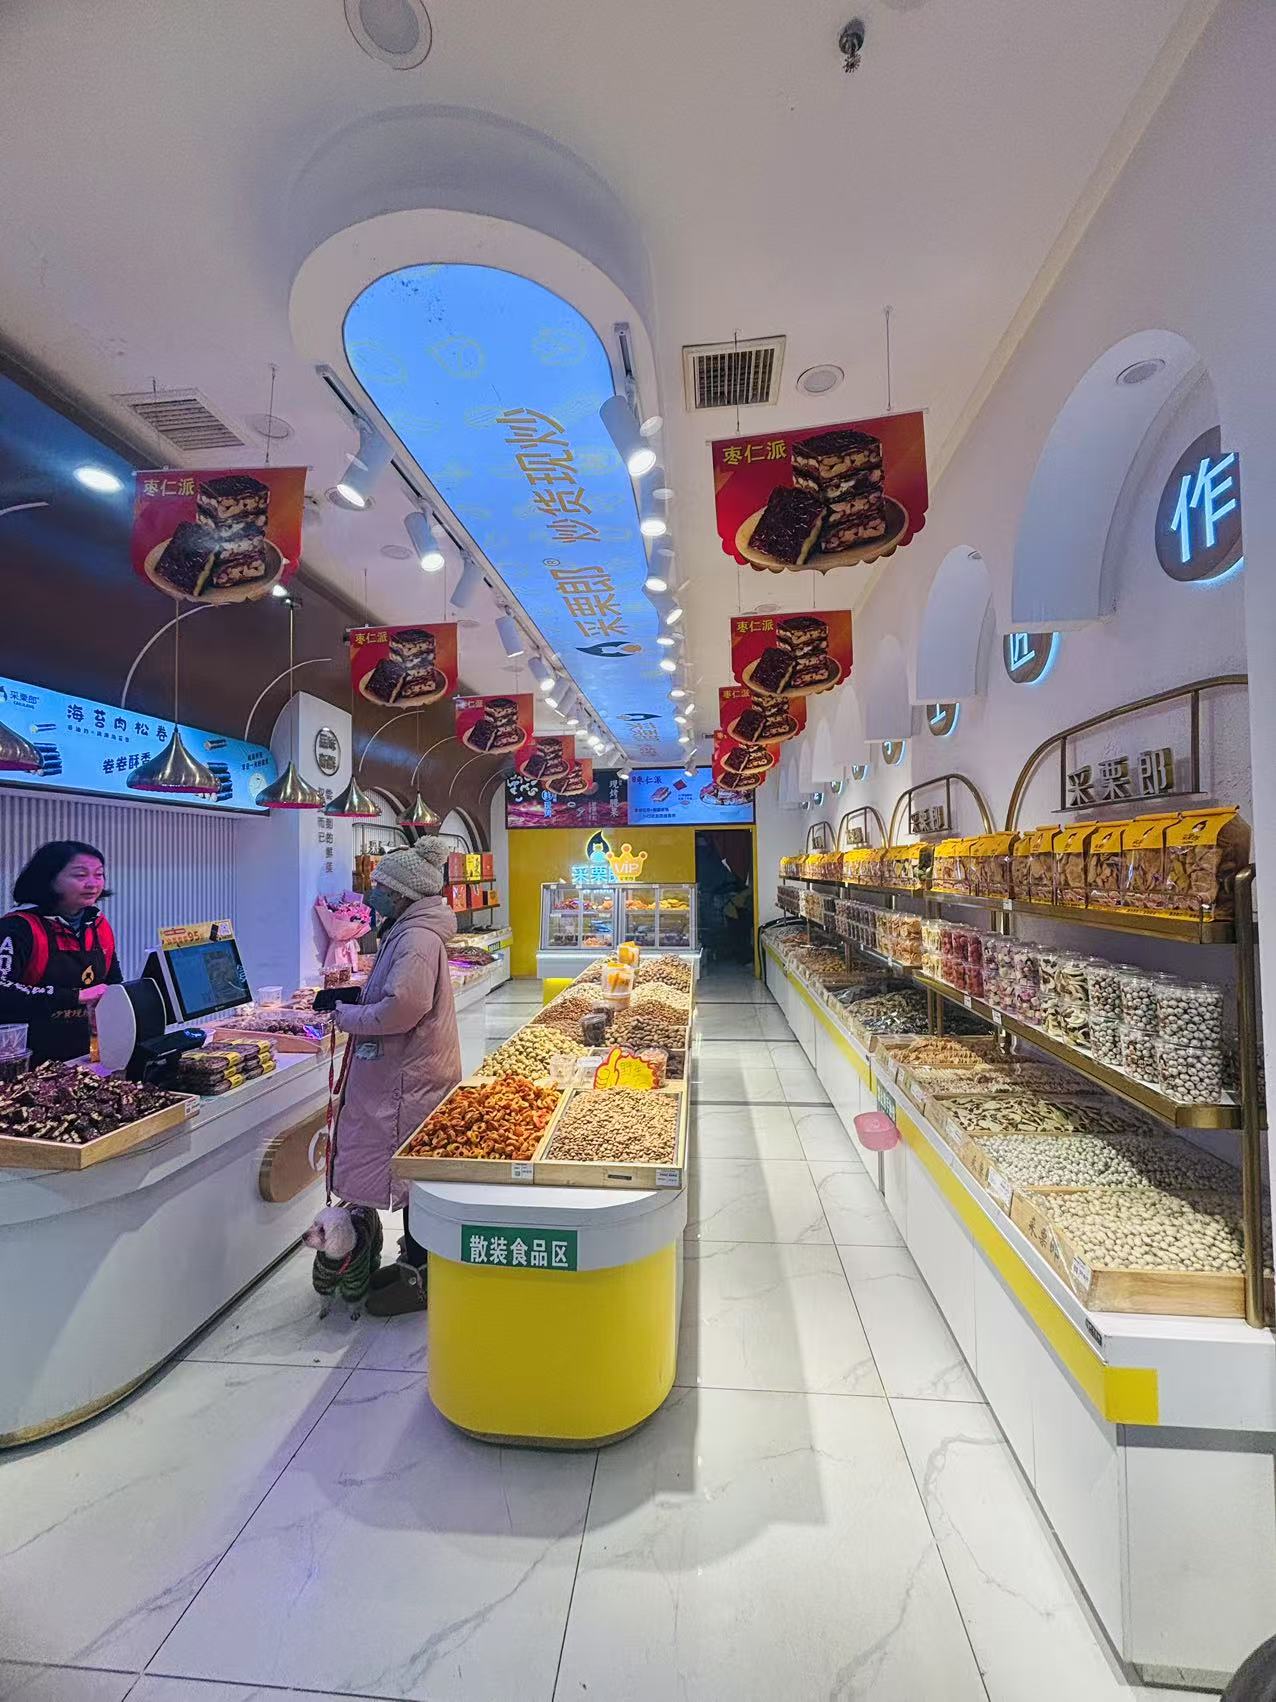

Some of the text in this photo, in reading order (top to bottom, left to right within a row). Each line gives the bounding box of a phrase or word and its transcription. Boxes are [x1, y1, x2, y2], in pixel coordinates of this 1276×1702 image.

[722, 440, 787, 465] 枣仁派
[143, 478, 195, 497] 枣仁派
[495, 406, 602, 543] 炒货现炒
[1170, 452, 1237, 563] 作
[354, 631, 388, 645] 枣仁派
[736, 619, 774, 633] 枣仁派
[66, 704, 168, 742] 海苔肉松卷
[1067, 747, 1176, 807] 采栗郎
[614, 863, 640, 874] VIP
[469, 1234, 569, 1267] 散装食品区
